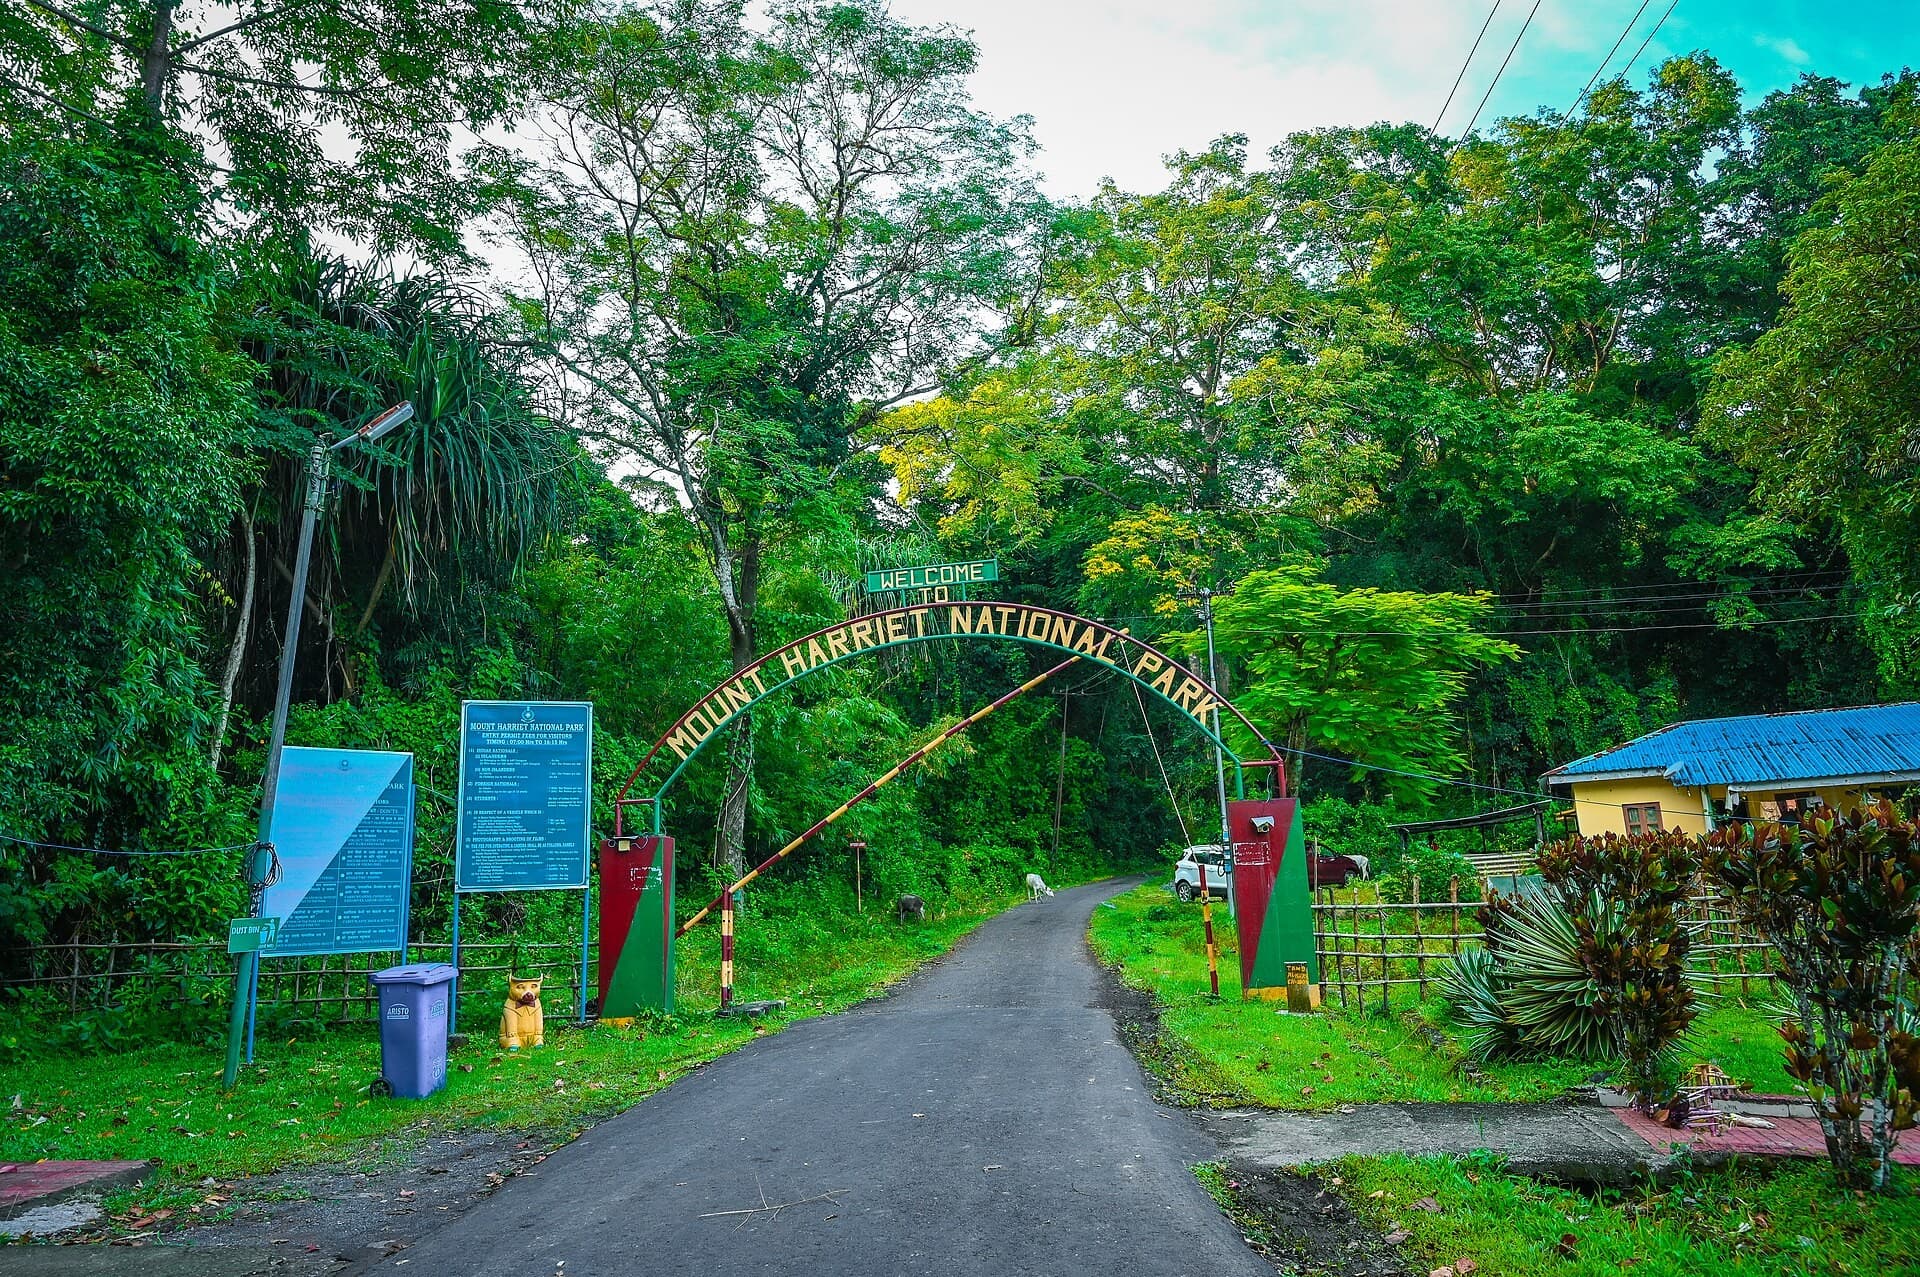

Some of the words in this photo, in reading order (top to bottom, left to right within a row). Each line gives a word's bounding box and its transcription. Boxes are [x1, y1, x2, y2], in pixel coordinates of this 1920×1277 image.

[881, 564, 984, 589] WELCOME
[918, 586, 949, 605] TO
[666, 665, 766, 760] MOUNT
[779, 604, 928, 678] HARRIET
[950, 606, 1116, 665] NATIONAL
[1132, 651, 1225, 728] PARK
[470, 723, 495, 731] MOUNT
[497, 723, 529, 731] HARRIET
[530, 723, 564, 731] NATIONAL
[566, 723, 585, 731] PARK
[232, 927, 248, 935] DUST
[249, 926, 260, 934] BIN
